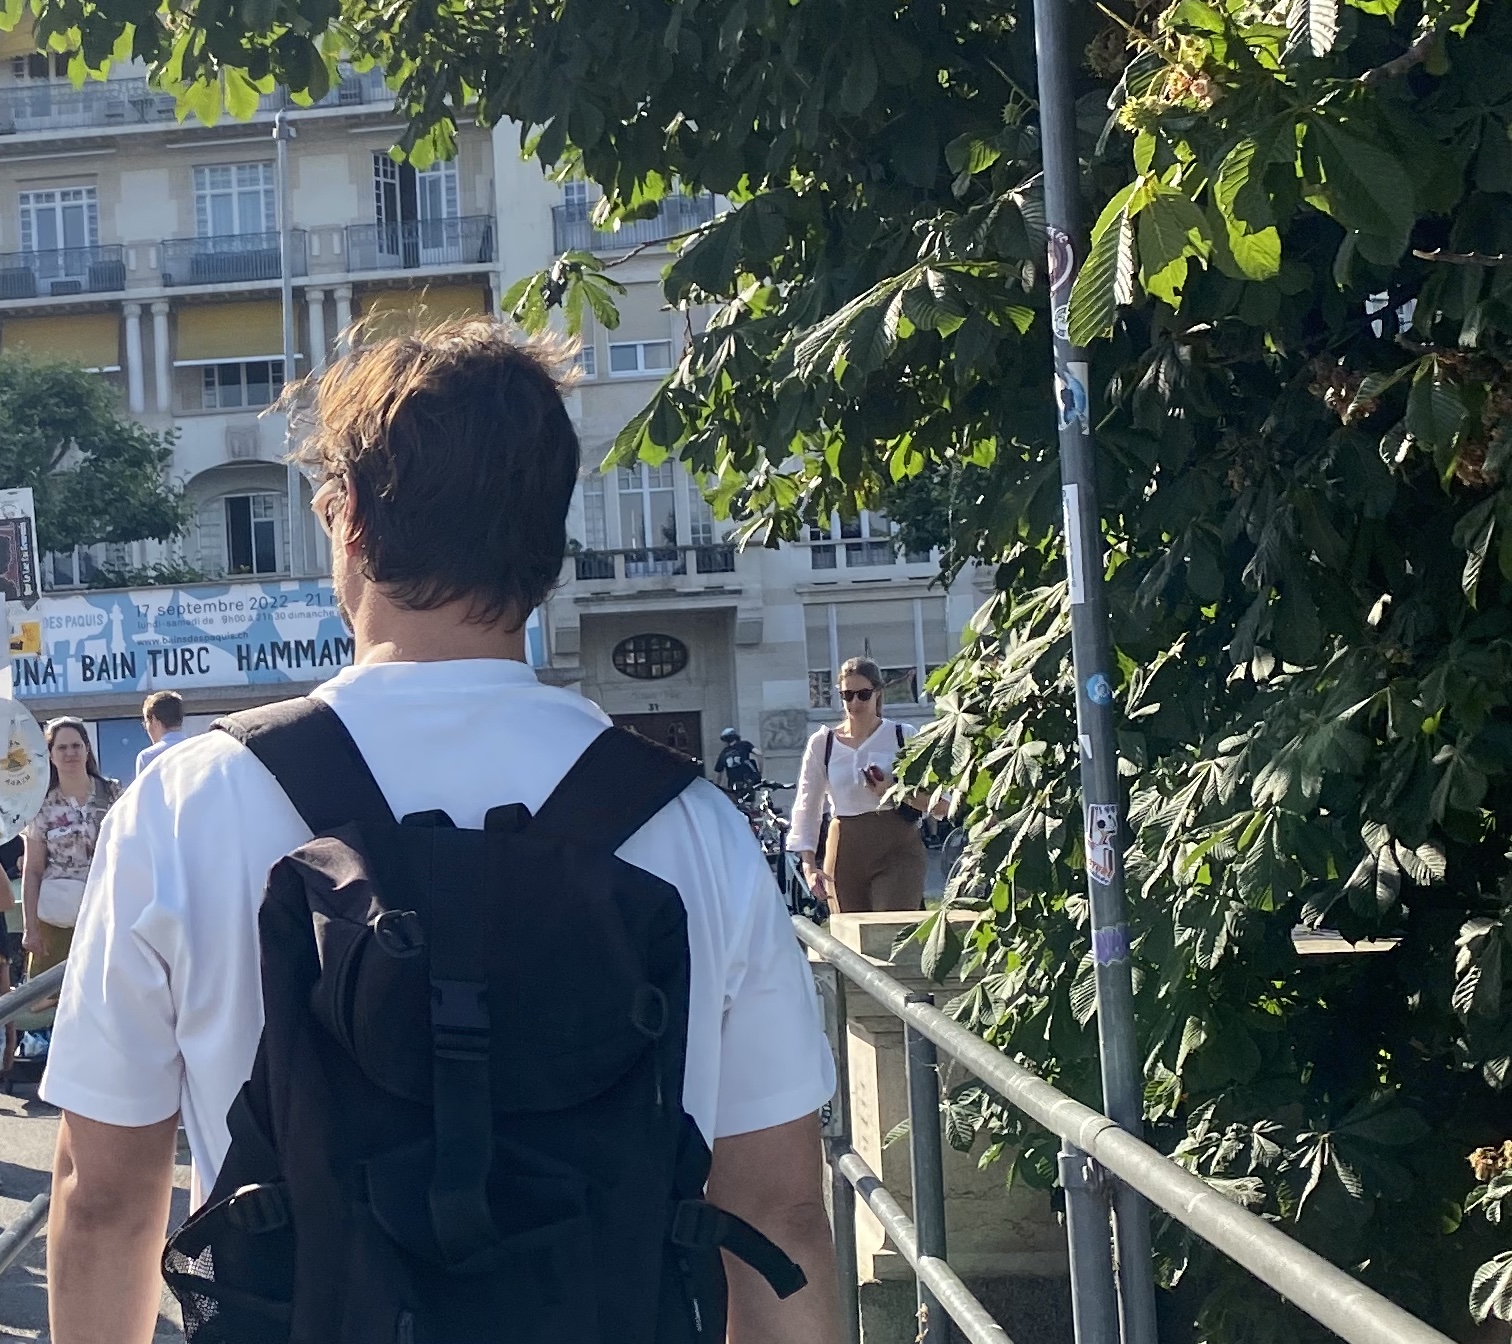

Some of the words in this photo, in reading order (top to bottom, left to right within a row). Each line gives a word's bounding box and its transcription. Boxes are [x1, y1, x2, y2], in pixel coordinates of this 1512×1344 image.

[136, 604, 150, 617] 17
[157, 599, 244, 619] septembre
[249, 595, 288, 610] 2022
[305, 592, 321, 607] 21
[43, 616, 63, 630] DES
[65, 614, 104, 628] PAQUIS
[202, 617, 214, 625] de
[288, 609, 334, 620] dimanche
[81, 651, 136, 682] BAIN
[147, 646, 210, 678] TURC
[236, 637, 355, 672] HAMMAM
